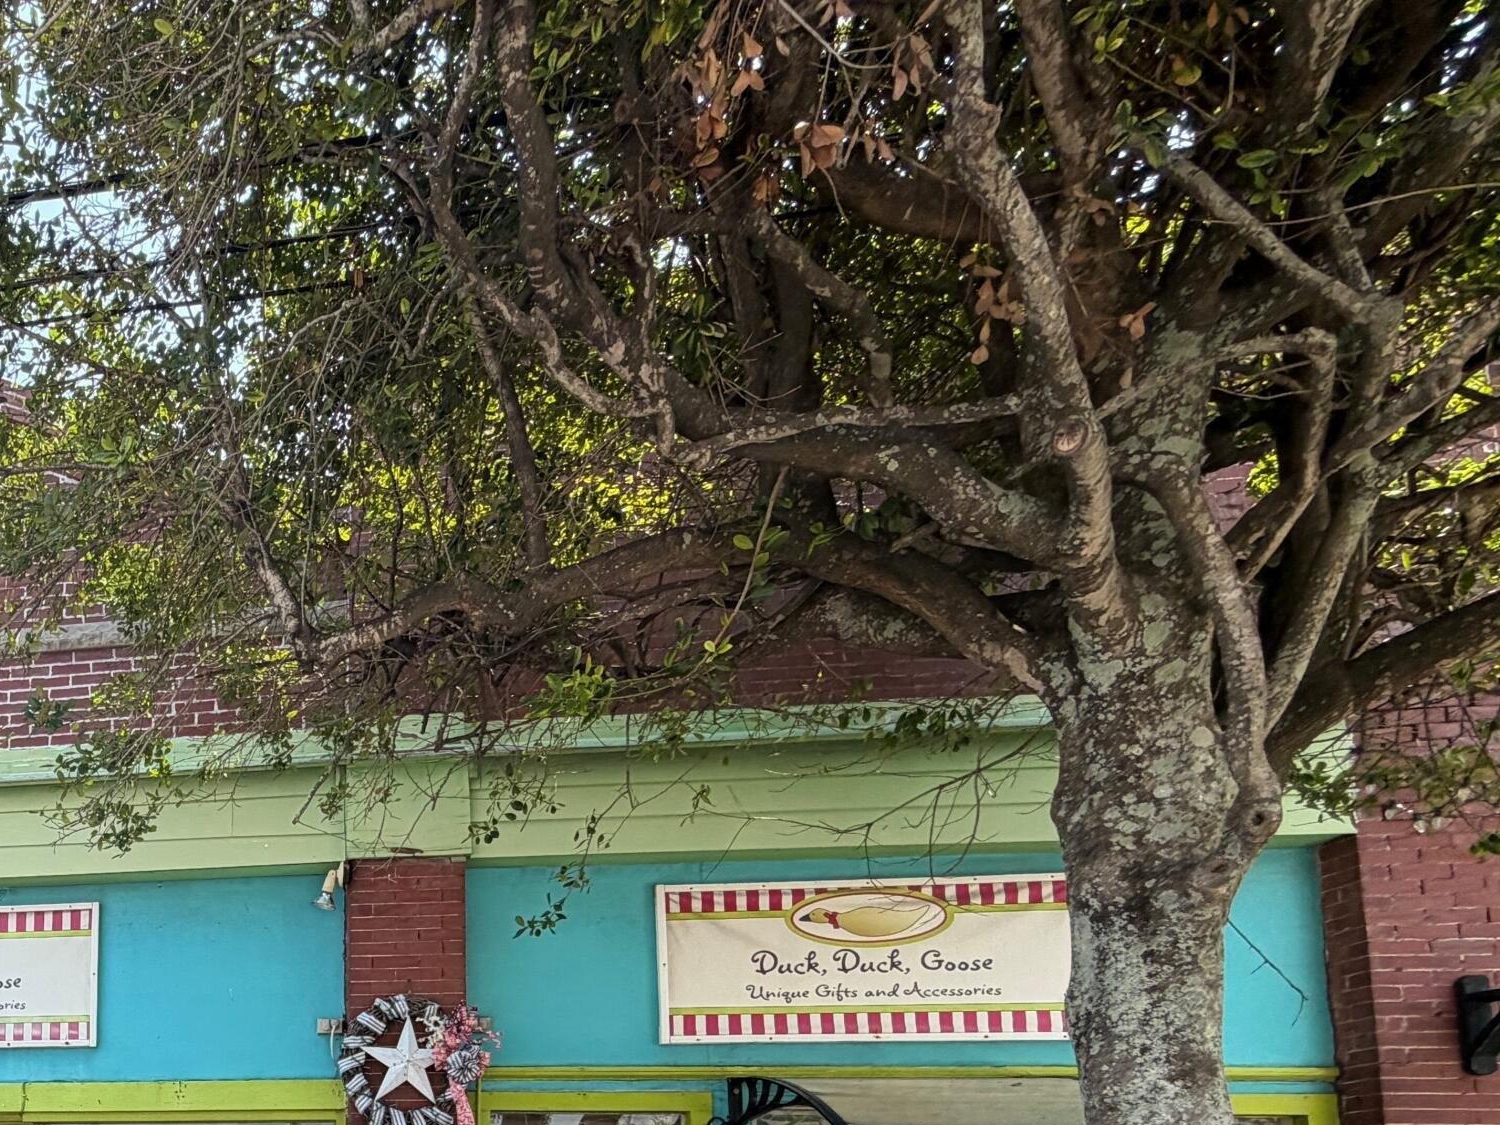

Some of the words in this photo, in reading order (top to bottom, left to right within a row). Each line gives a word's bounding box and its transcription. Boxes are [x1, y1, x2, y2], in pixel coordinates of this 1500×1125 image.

[750, 950, 828, 977] Duck,
[832, 948, 910, 976] Duck,
[921, 949, 994, 973] Goose
[745, 984, 809, 1004] Unique
[815, 983, 858, 1003] Gifts
[864, 983, 899, 998] and
[903, 981, 1002, 999] Accessories
